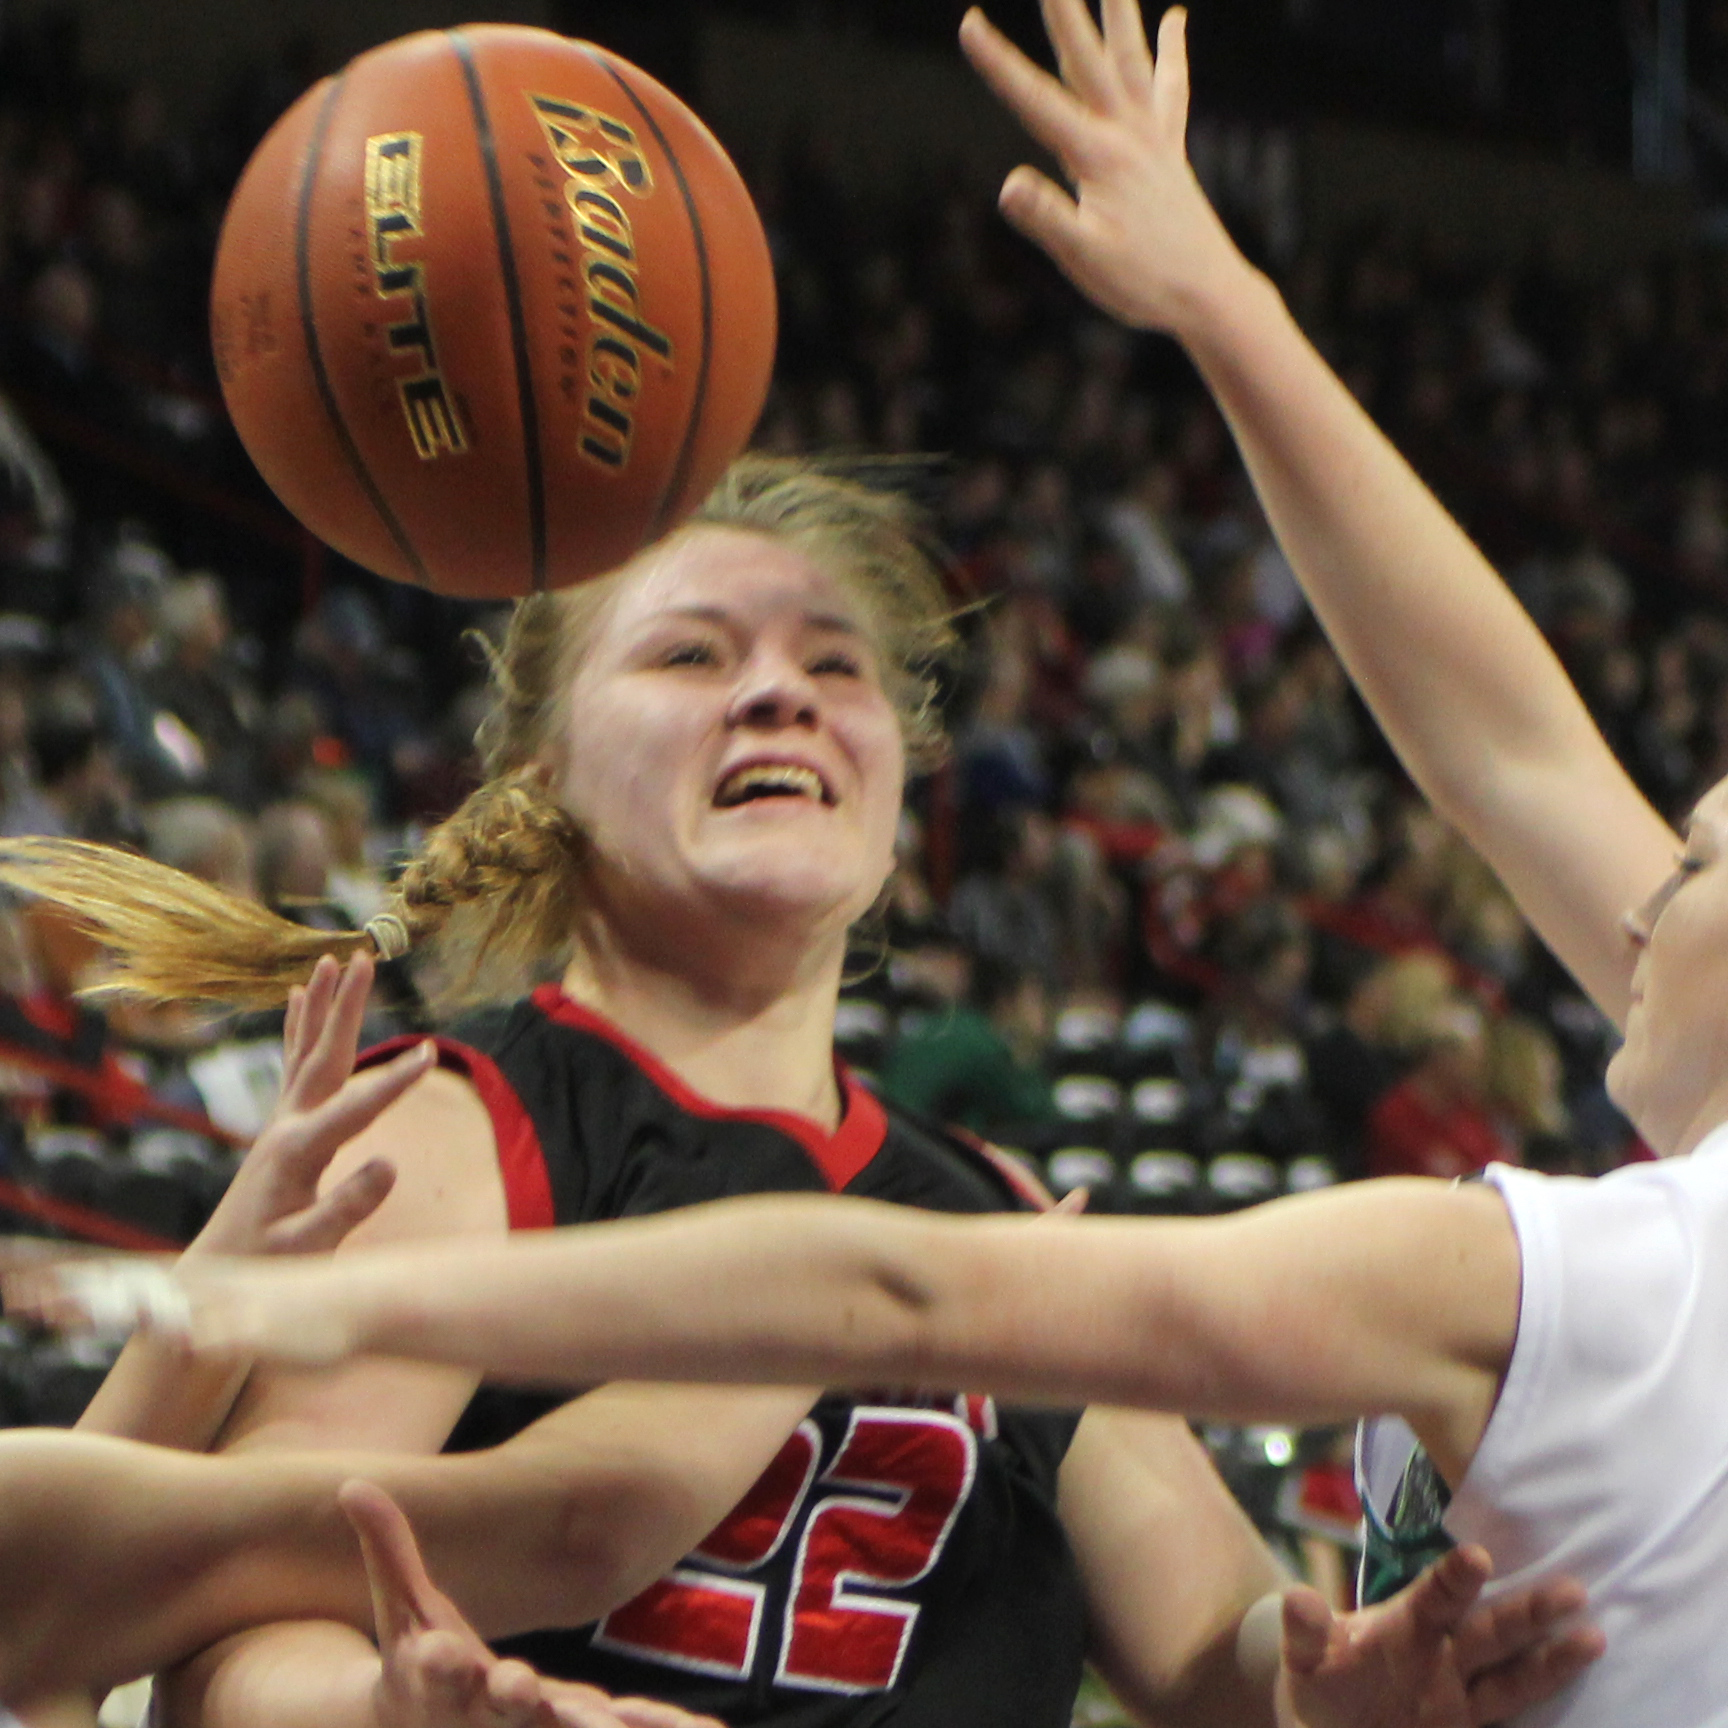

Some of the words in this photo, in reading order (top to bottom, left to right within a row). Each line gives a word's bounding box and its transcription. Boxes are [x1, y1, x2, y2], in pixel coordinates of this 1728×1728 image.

[365, 130, 469, 461] ELITE
[524, 89, 674, 476] Baden
[590, 1405, 977, 1695] 22
